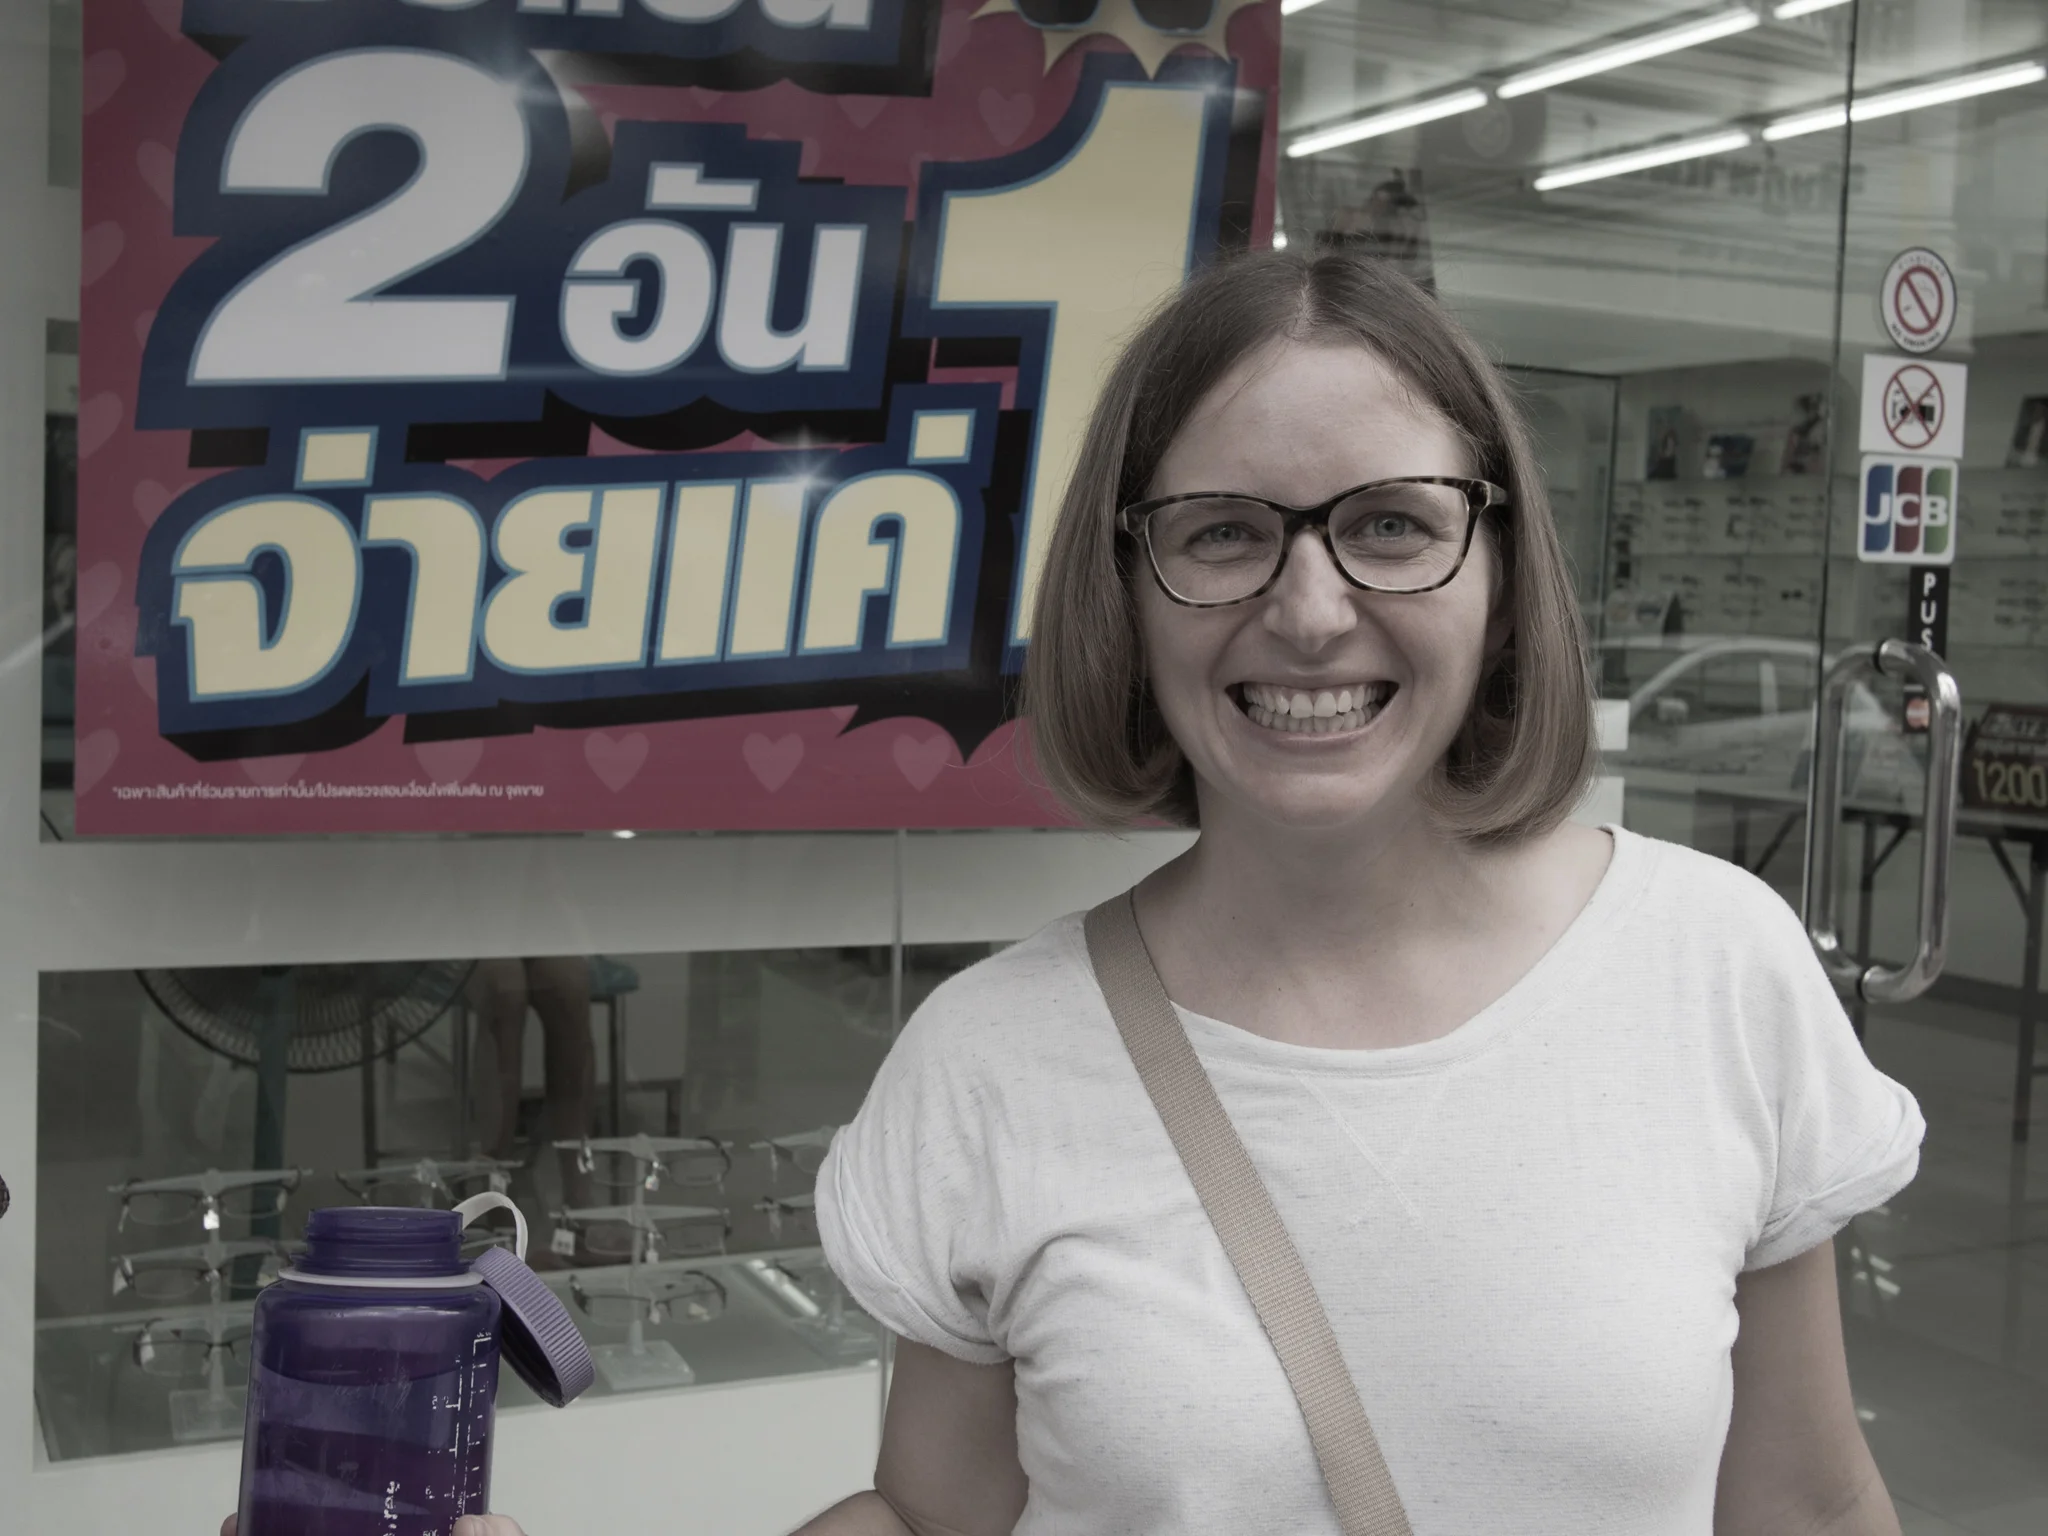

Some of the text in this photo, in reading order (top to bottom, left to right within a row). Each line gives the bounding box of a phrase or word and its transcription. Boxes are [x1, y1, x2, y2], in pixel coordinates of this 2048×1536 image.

[188, 51, 868, 386] 2 อัน
[171, 83, 1208, 703] จ่ายแค่ 1
[1864, 494, 1949, 526] JCB
[1920, 573, 1936, 653] PUS
